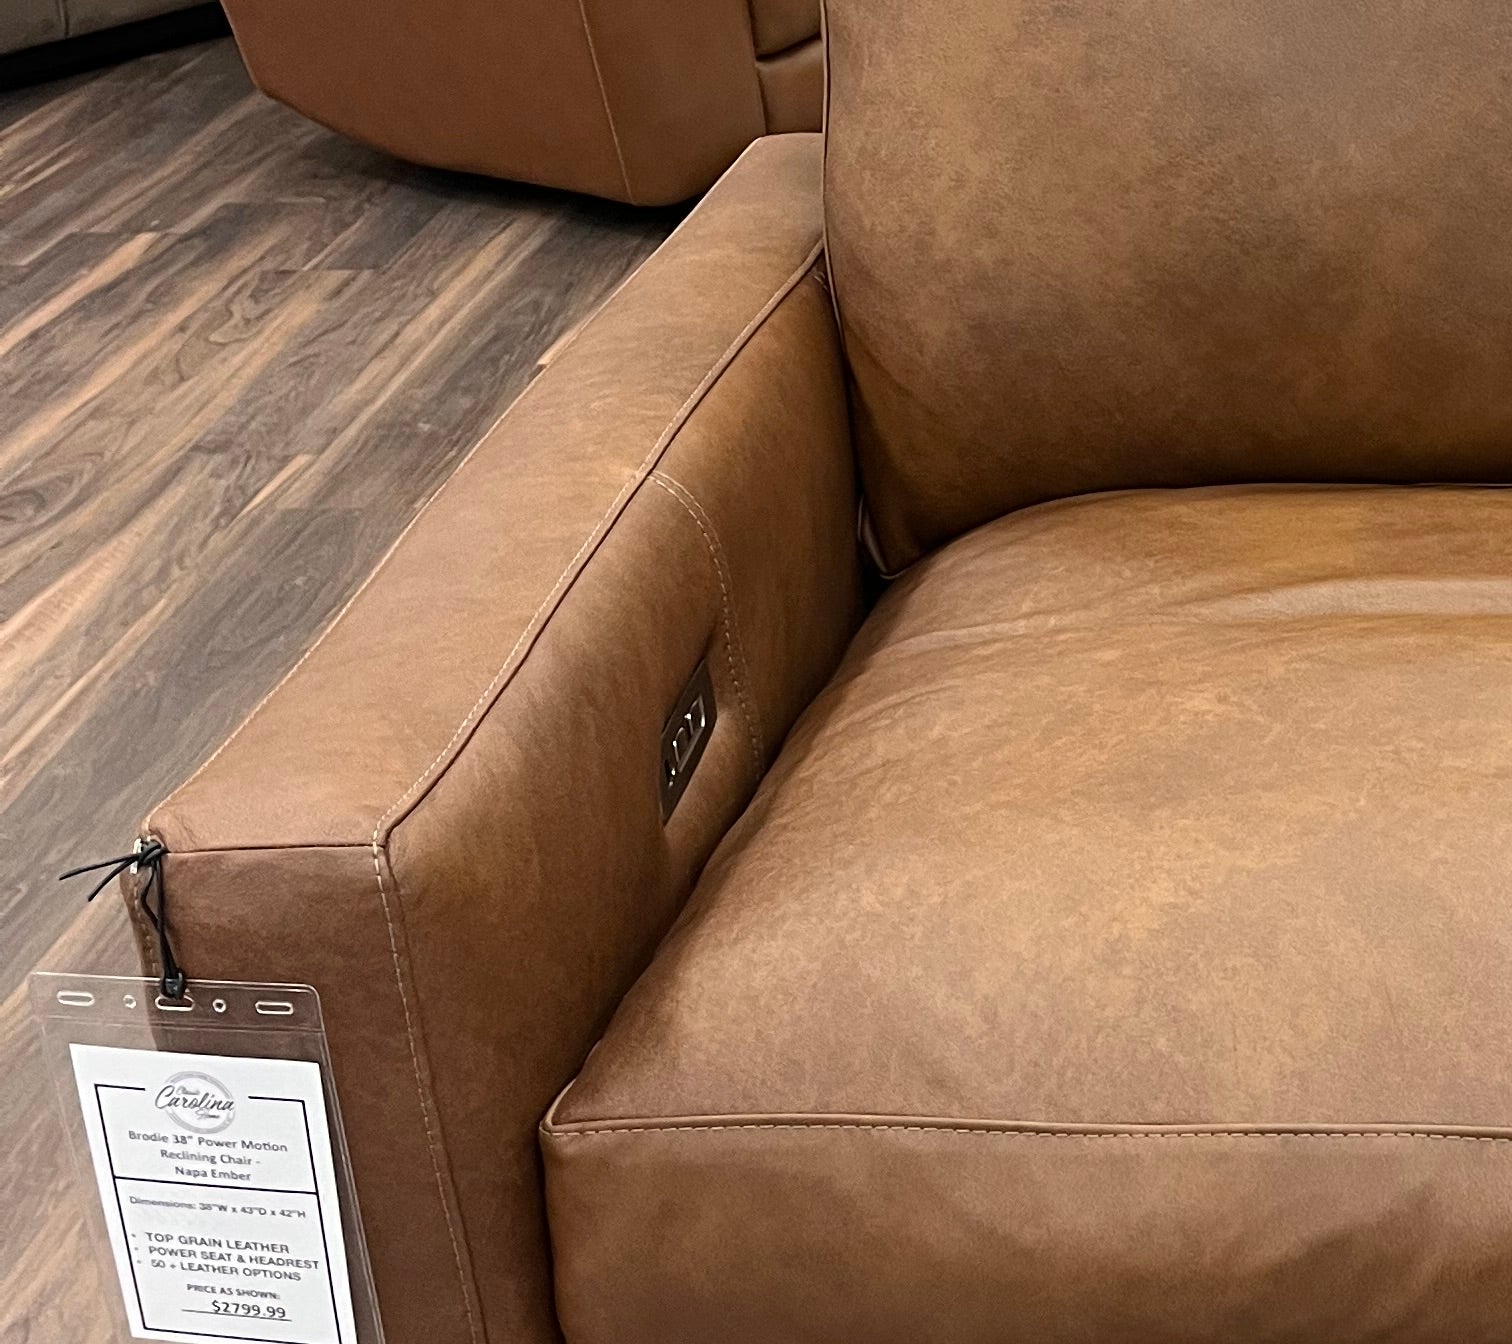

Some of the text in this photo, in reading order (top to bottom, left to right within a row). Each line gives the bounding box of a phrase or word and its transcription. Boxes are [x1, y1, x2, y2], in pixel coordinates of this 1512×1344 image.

[154, 1084, 235, 1111] Carolina
[128, 1130, 169, 1143] Brodie
[198, 1136, 238, 1149] Power
[241, 1140, 288, 1152] Motion
[160, 1149, 217, 1164] Reclining
[220, 1154, 253, 1165] Chair
[175, 1166, 252, 1181] Napa Ember
[145, 1232, 289, 1254] TOP GRAIN LEATHER
[149, 1245, 319, 1270] POWER SEAT & HEADREST
[151, 1258, 165, 1268] 50
[180, 1261, 239, 1275] LEATHER
[242, 1267, 301, 1281] OPTIONS
[186, 1283, 280, 1300] PRICE AS SHOWN:
[211, 1299, 286, 1319] $2799.99
